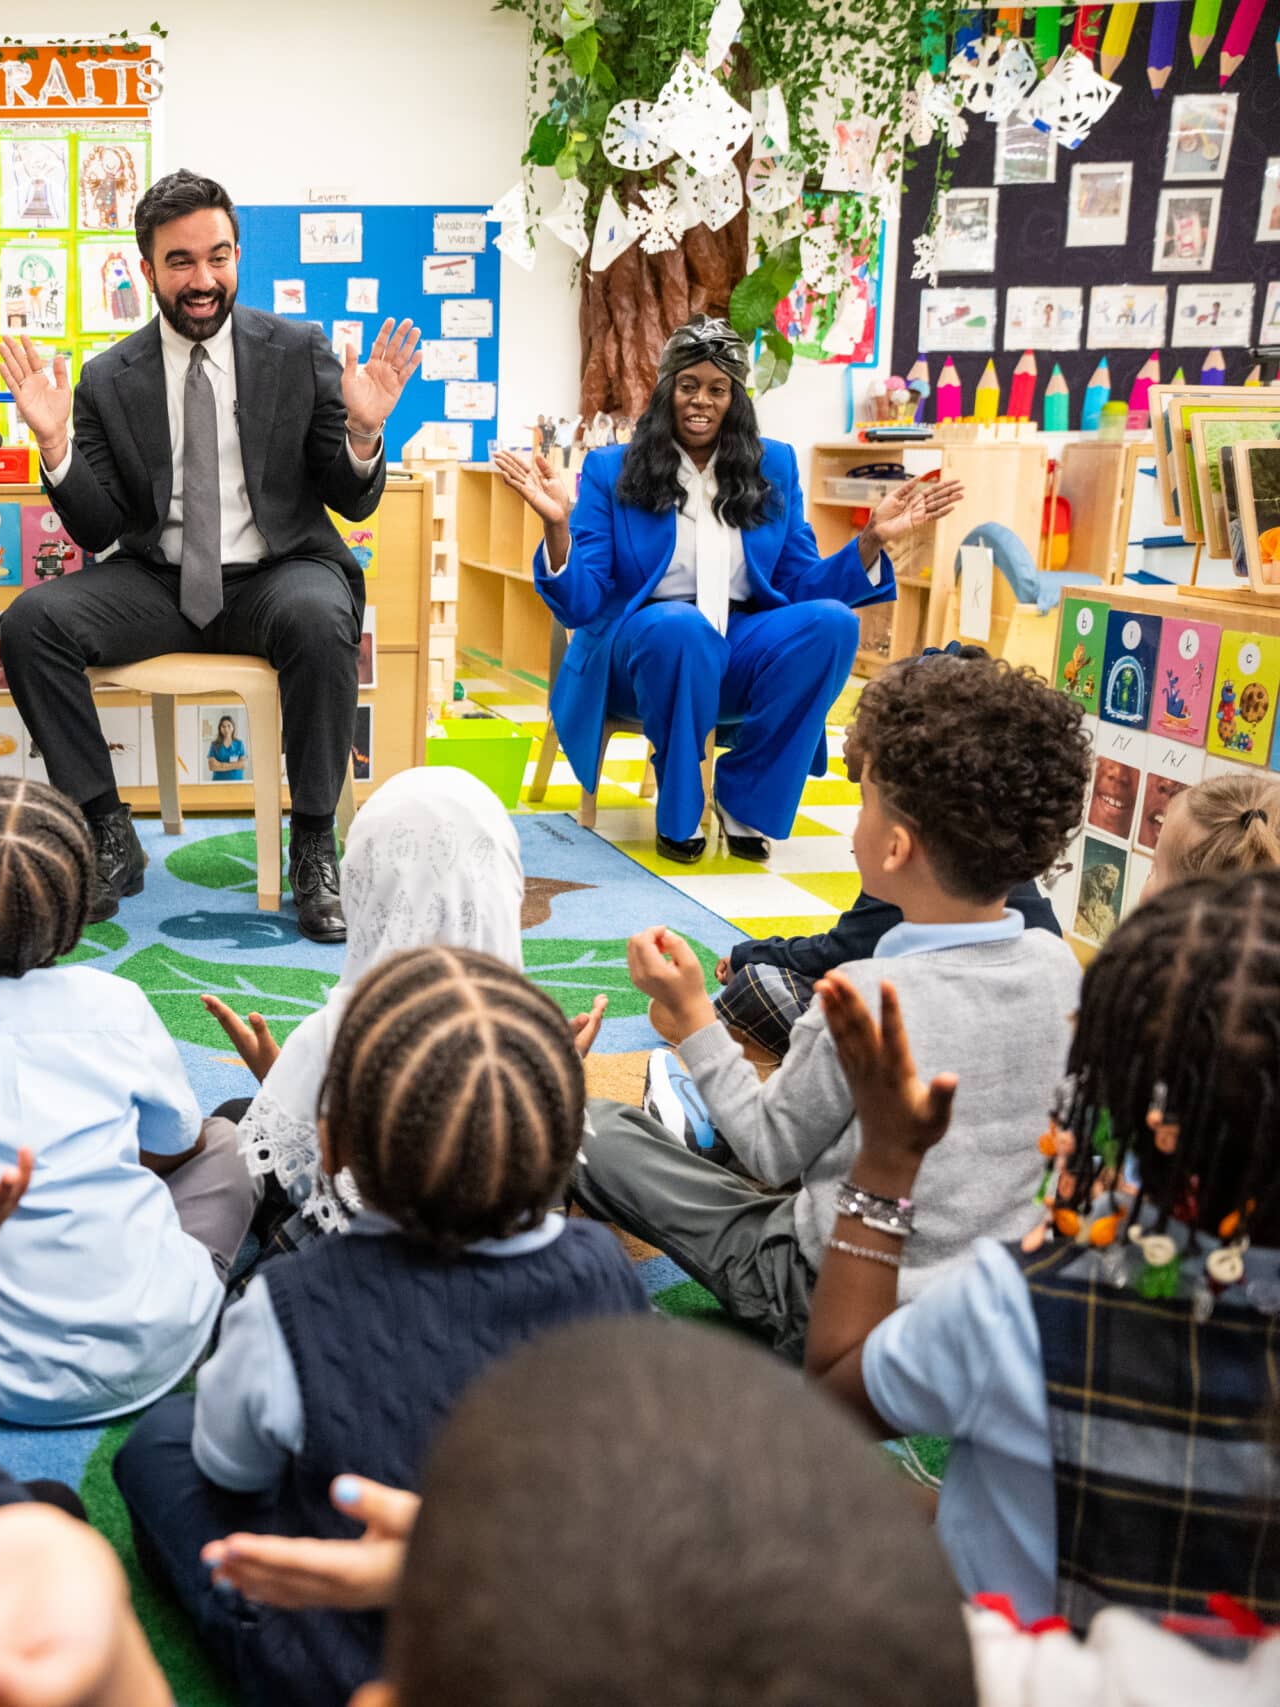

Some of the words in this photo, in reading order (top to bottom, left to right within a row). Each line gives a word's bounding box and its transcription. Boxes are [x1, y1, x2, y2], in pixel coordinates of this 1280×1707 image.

[309, 188, 348, 203] Levers
[435, 222, 482, 233] Vocabulary
[448, 235, 476, 245] Words
[48, 516, 54, 528] t
[1185, 634, 1192, 652] k
[1245, 653, 1253, 664] c
